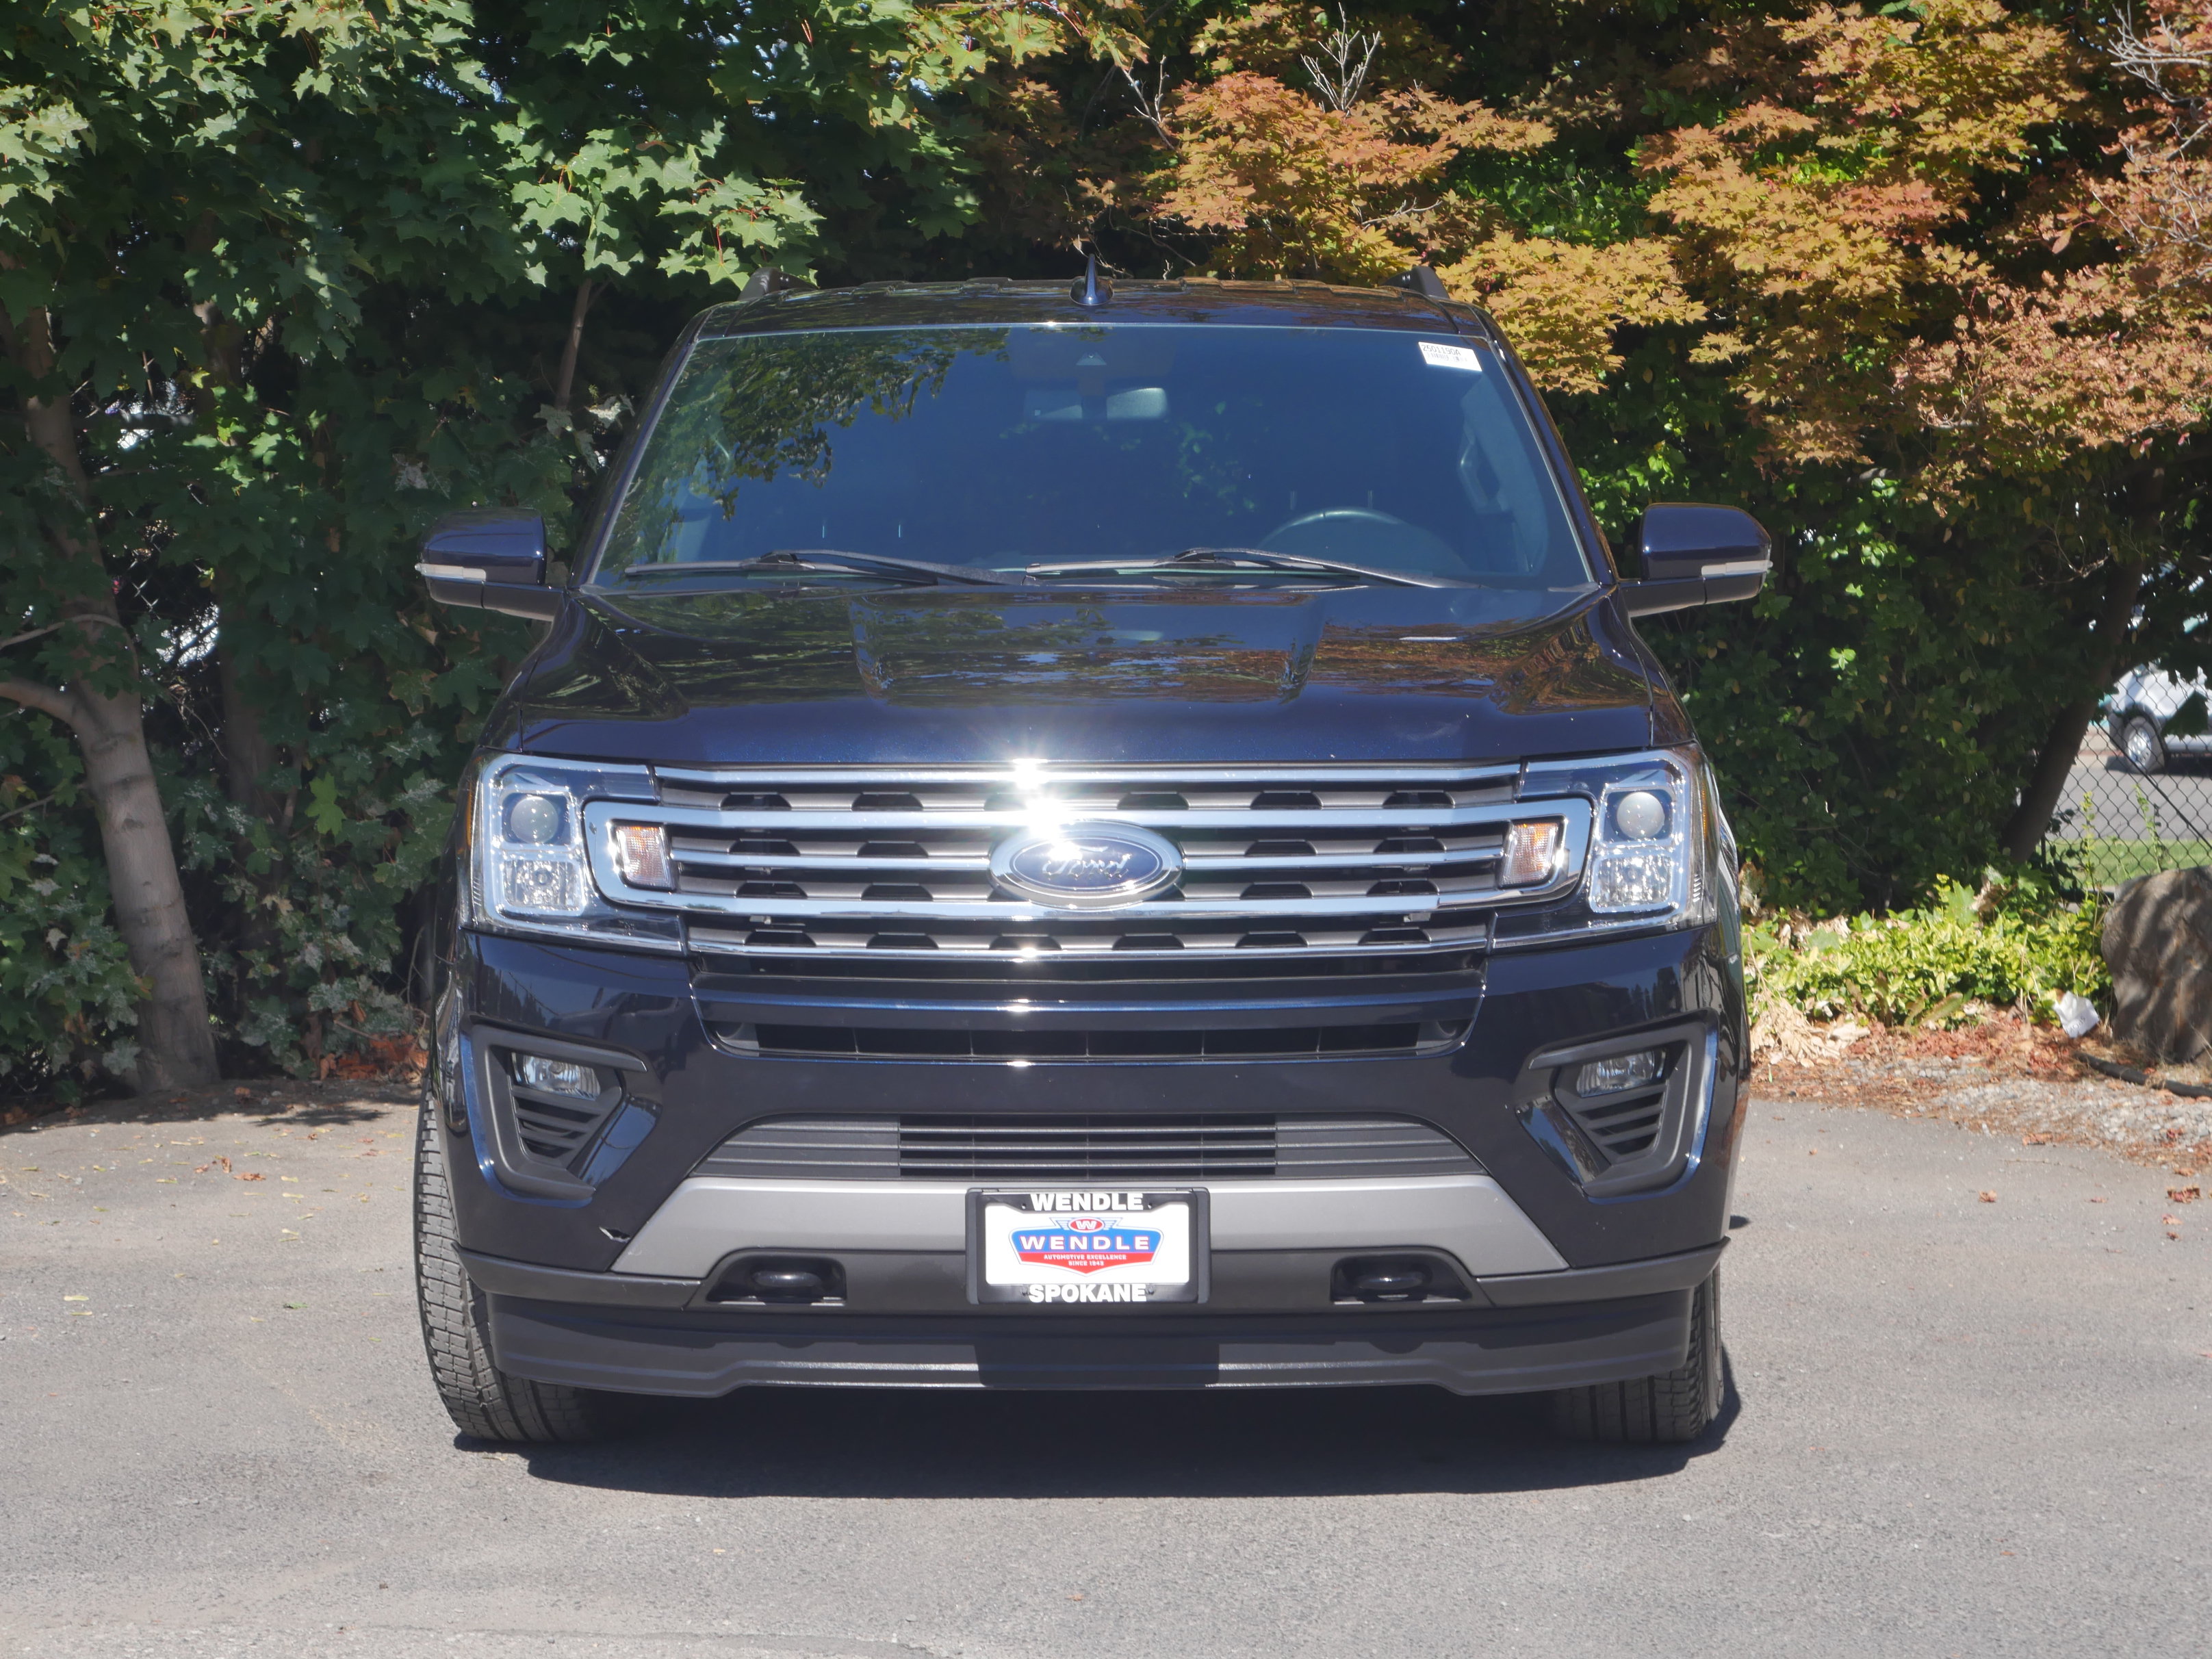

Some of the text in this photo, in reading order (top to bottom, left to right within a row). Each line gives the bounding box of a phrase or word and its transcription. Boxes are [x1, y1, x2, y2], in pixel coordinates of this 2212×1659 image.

[1031, 1193, 1144, 1211] WENDLE
[1020, 1236, 1150, 1250] WENDLE
[1029, 1284, 1147, 1303] SPOKANE
